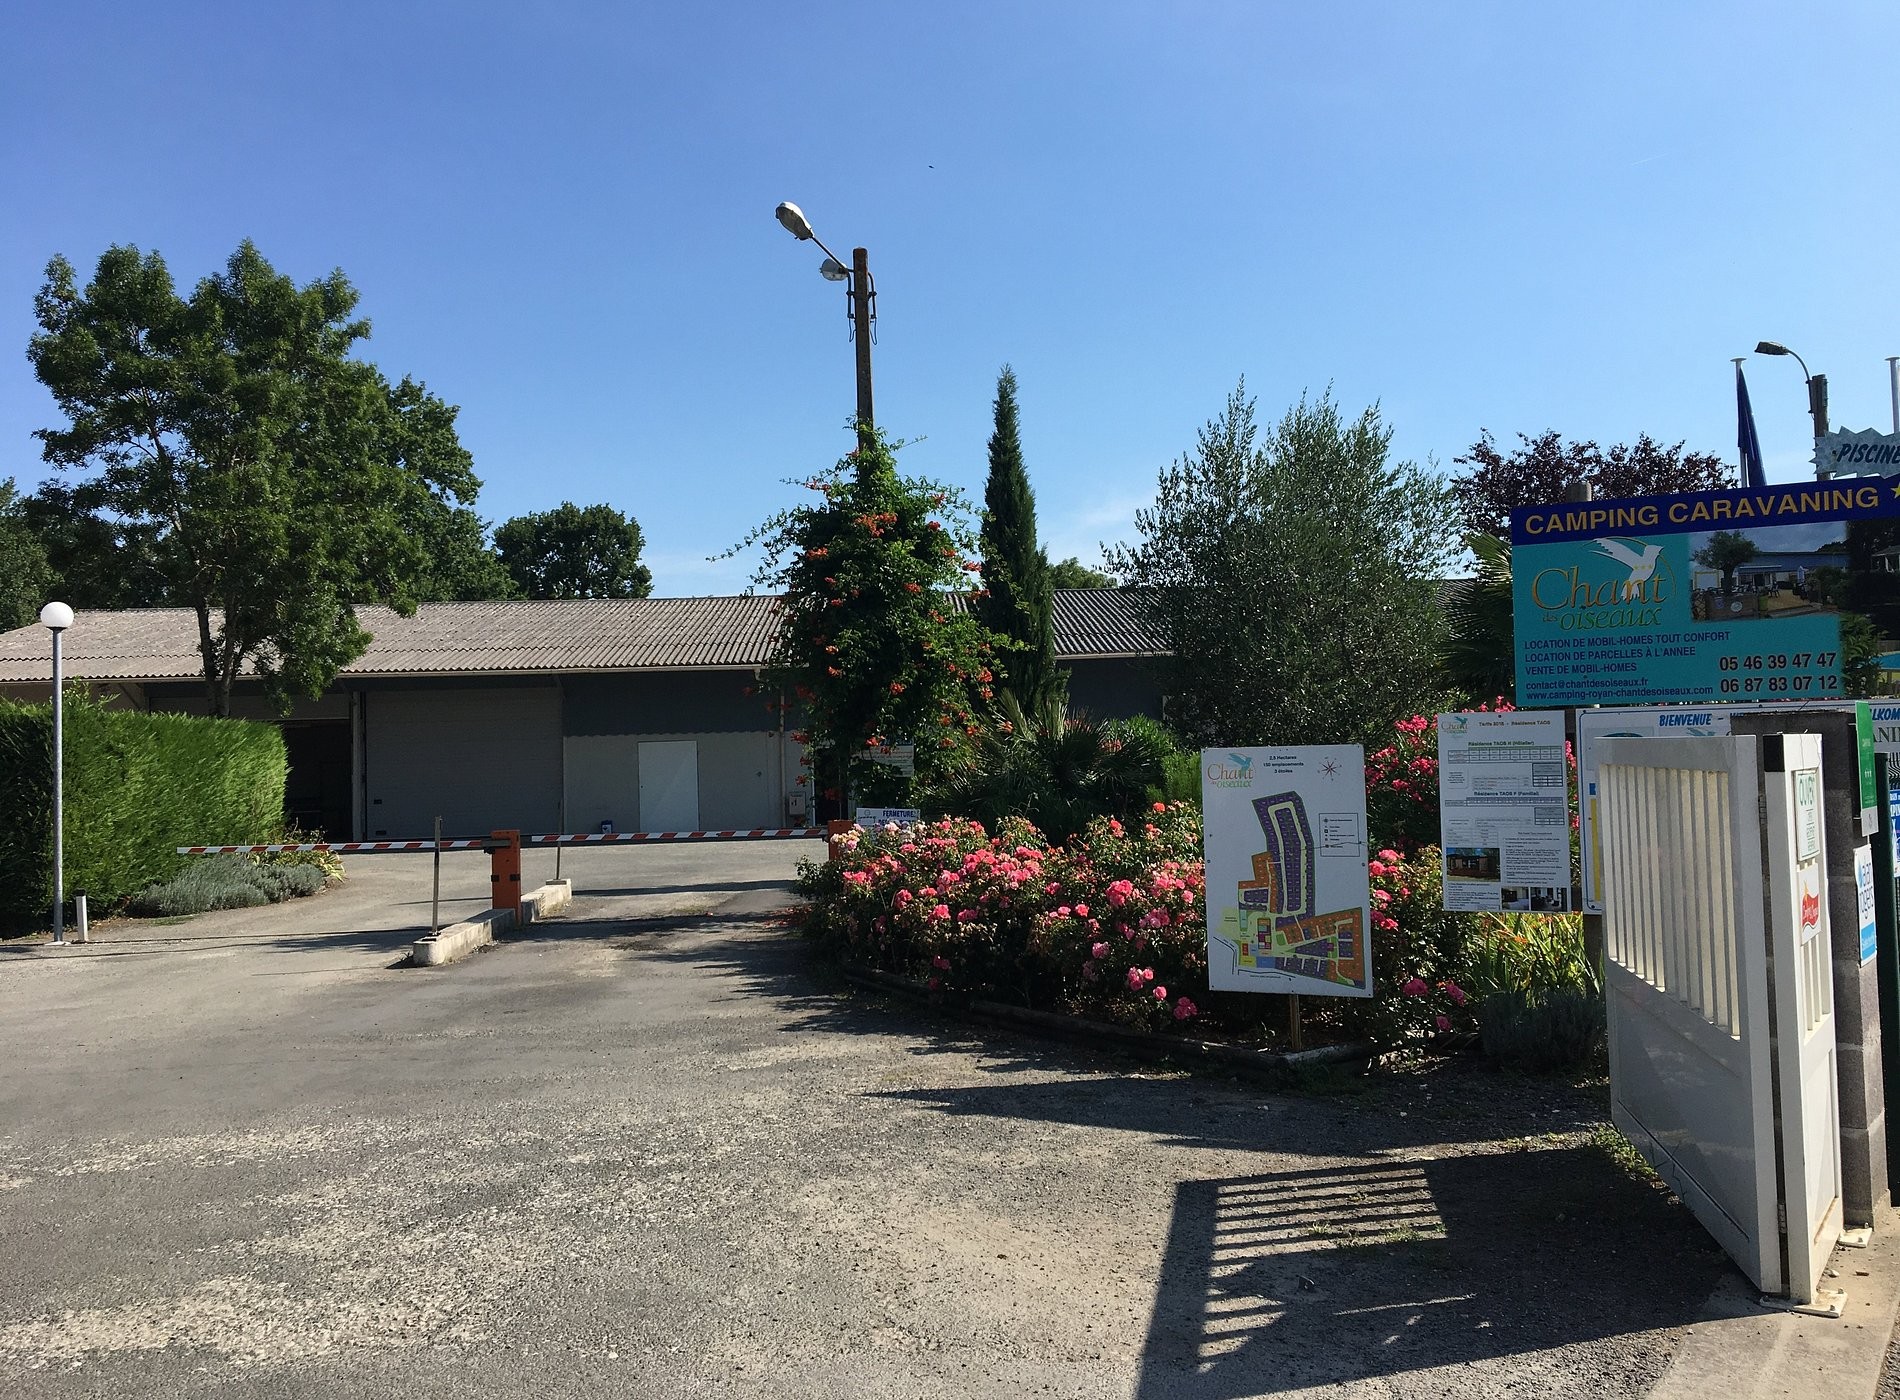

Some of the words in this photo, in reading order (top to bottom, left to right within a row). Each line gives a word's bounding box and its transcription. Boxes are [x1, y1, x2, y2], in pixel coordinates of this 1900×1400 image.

[1837, 443, 1900, 464] PISCINE
[1525, 505, 1659, 535] CAMPING
[1669, 486, 1879, 523] CARAVANING
[1532, 565, 1668, 611] Chant
[1560, 607, 1662, 631] oiseaux
[1525, 638, 1571, 649] LOCATION
[1573, 638, 1585, 648] DE
[1588, 635, 1653, 647] MOBIL-HOMES
[1656, 633, 1681, 644] TOUT
[1683, 631, 1731, 643] CONFORT
[1525, 652, 1571, 663] LOCATION
[1573, 650, 1586, 660] DE
[1588, 649, 1643, 660] PARCELLES
[1645, 646, 1653, 657] À
[1719, 656, 1738, 671] 05
[1743, 655, 1763, 670] 46
[1768, 654, 1787, 669] 39
[1792, 653, 1812, 668] 47
[1817, 652, 1837, 667] 47
[1525, 665, 1555, 676] VENTE
[1557, 665, 1569, 674] DE
[1571, 663, 1637, 674] MOBIL-HOMES
[1526, 677, 1649, 690] contact@chantdesoiseaux.fr
[1720, 678, 1739, 693] 06
[1744, 677, 1763, 692] 87
[1768, 676, 1788, 691] 83
[1793, 675, 1813, 690] 07
[1818, 675, 1838, 690] 12
[1526, 686, 1713, 700] www.camping-royan-chantdesoiseaux.com
[1659, 713, 1712, 726] BIENVENUE
[1207, 763, 1253, 780] Chant
